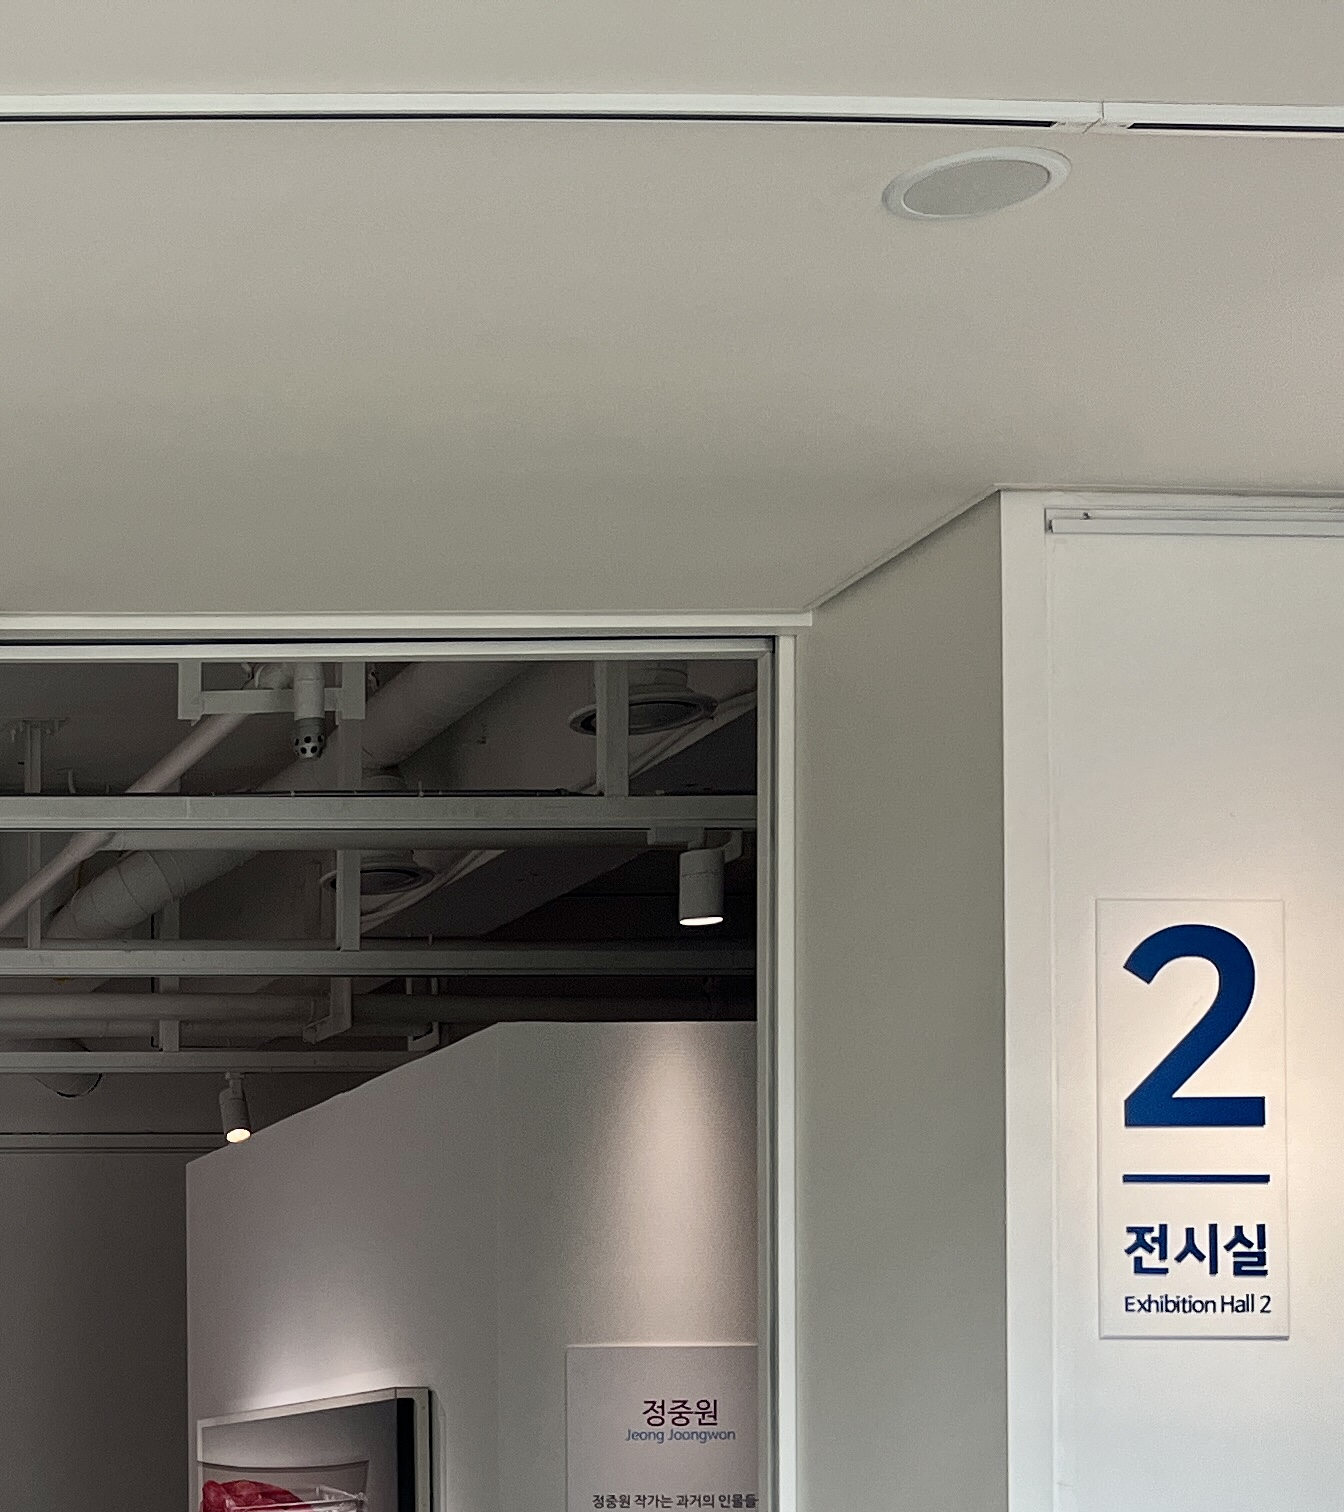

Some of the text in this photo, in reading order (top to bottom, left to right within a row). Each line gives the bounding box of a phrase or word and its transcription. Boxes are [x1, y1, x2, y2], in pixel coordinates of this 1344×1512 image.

[1122, 923, 1266, 1128] 2
[1124, 1222, 1270, 1277] 전시실
[1124, 1293, 1272, 1314] Exhibition Hall 2
[642, 1399, 718, 1427] 정중원
[625, 1428, 736, 1444] Jeong Joongwon
[592, 1493, 631, 1509] 정중원
[634, 1493, 674, 1509] 작가는
[676, 1493, 715, 1509] 과거의
